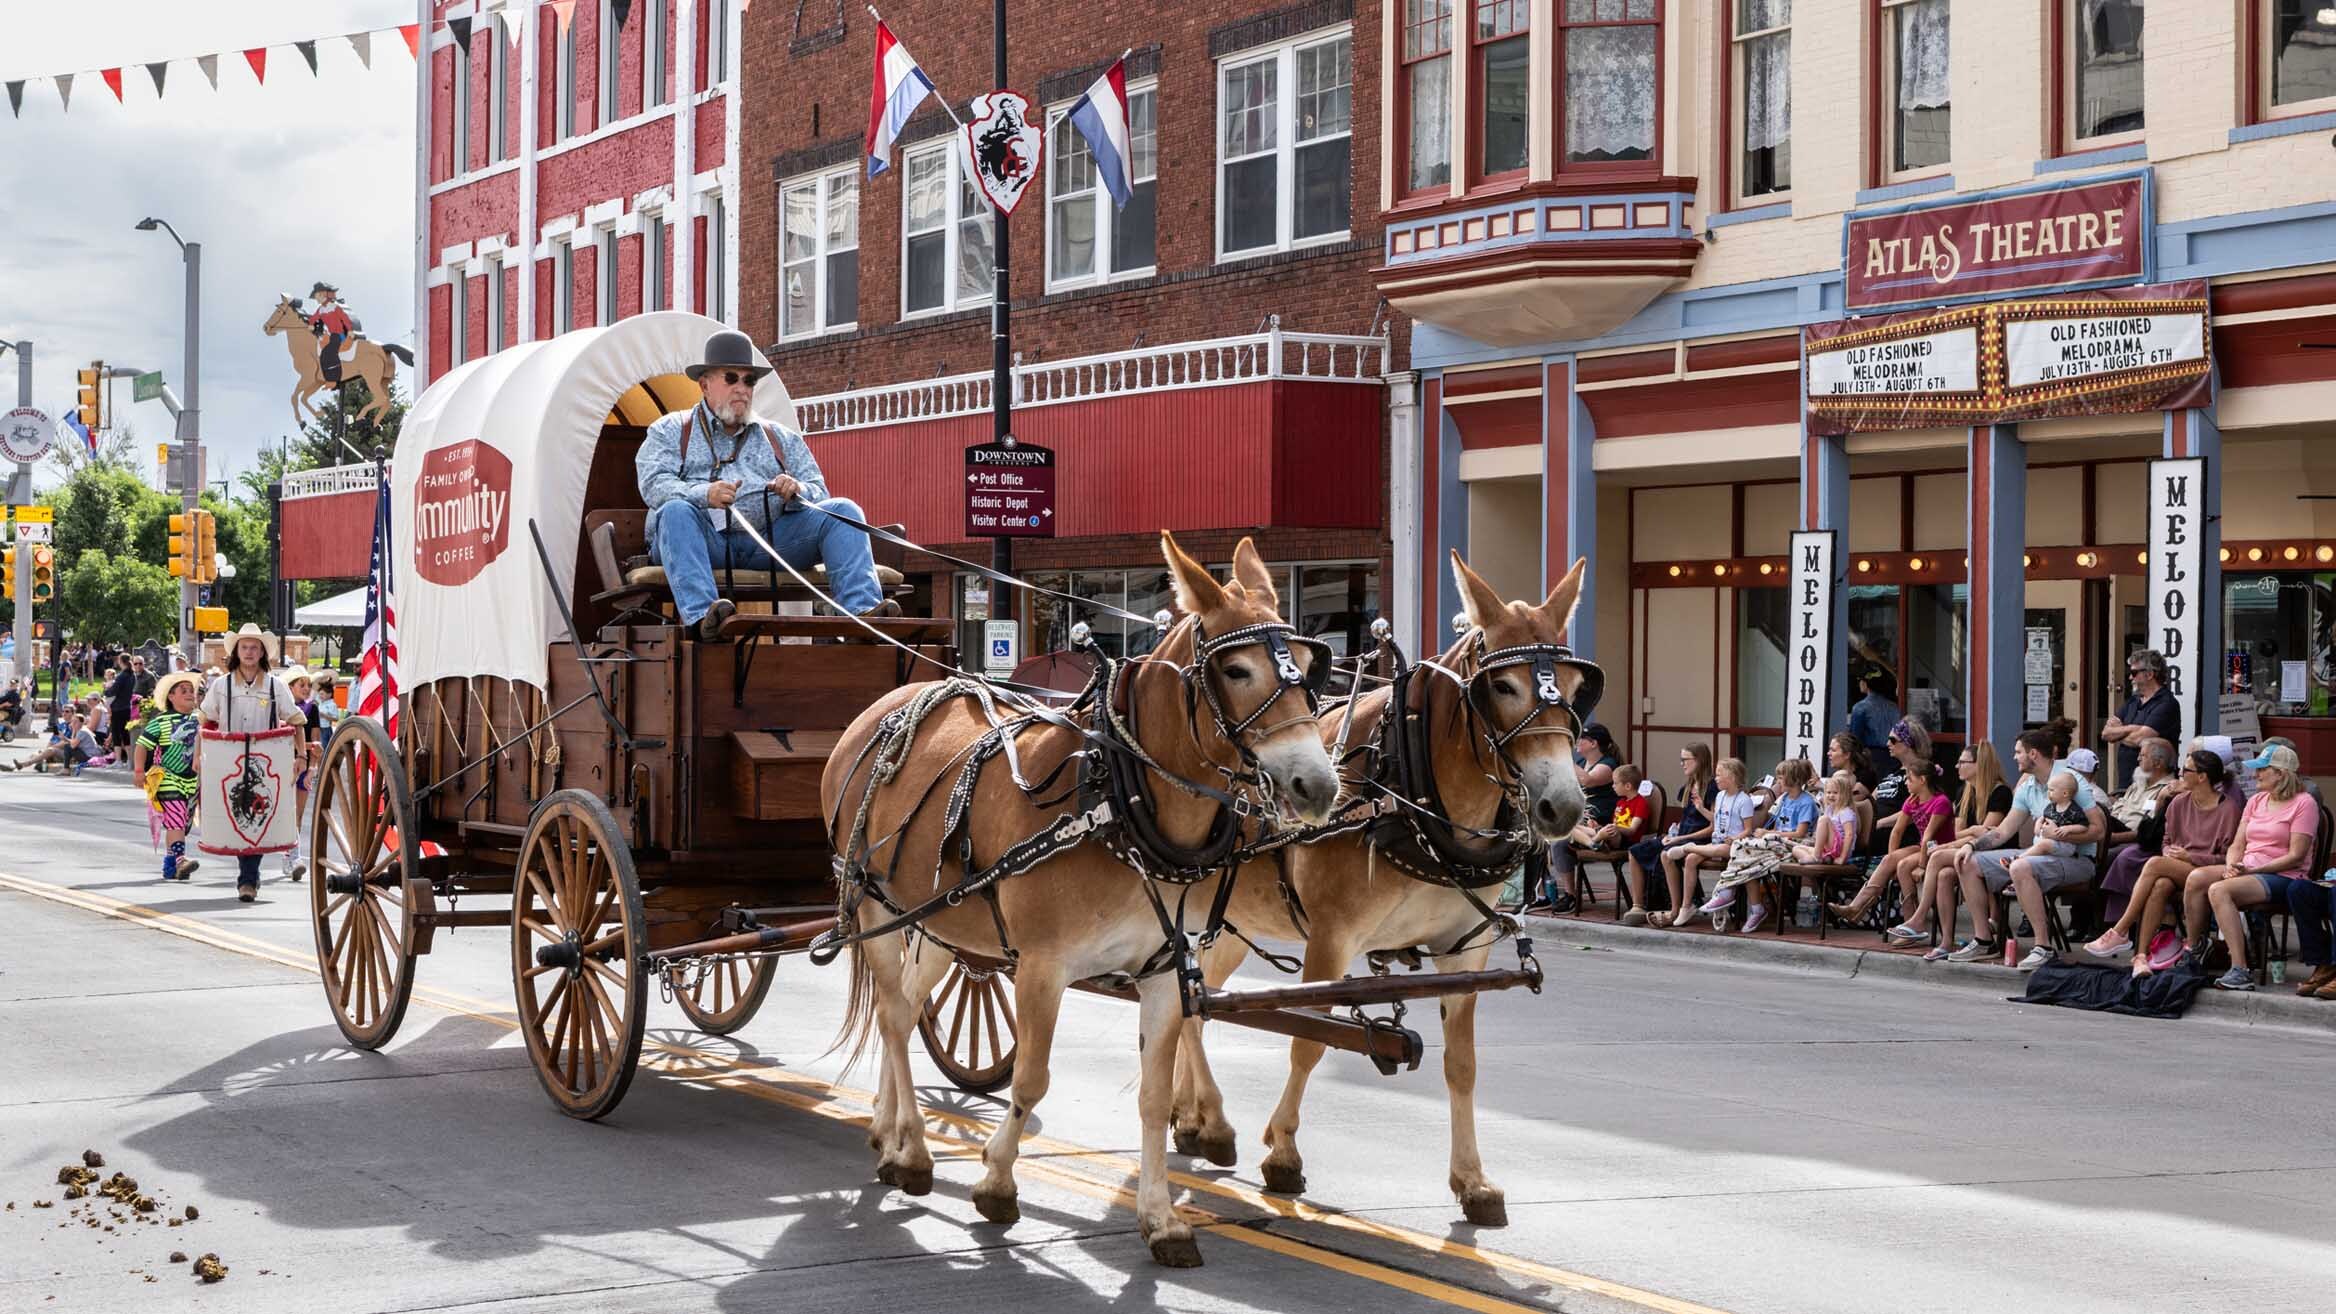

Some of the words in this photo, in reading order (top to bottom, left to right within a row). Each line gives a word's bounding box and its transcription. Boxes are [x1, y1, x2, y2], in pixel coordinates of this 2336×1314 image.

[1863, 224, 1961, 284] ATLAS
[1969, 208, 2124, 265] THEATRE
[2050, 324, 2076, 342] OLD
[2080, 317, 2151, 339] FASHIONED
[1847, 348, 1866, 365] OLD
[1869, 340, 1932, 362] FASHIONED
[2061, 337, 2143, 362] MELODRAMA
[1853, 361, 1923, 380] MELODRAMA
[2039, 366, 2064, 381] JULY
[2066, 361, 2091, 376] 13TH
[2103, 352, 2145, 371] AUGUST
[2150, 348, 2173, 364] 6TH
[1831, 381, 1854, 394] JULY
[1855, 380, 1876, 393] 13TH
[1885, 377, 1923, 391] AUGUST
[1927, 376, 1946, 390] 6TH
[974, 450, 1046, 464] DOWNTOWN
[424, 472, 458, 489] FAMILY
[980, 472, 997, 485] Post
[1001, 473, 1024, 485] Office
[417, 478, 506, 541] ommunity
[971, 496, 1002, 508] Historic
[1006, 496, 1028, 511] Depot
[972, 514, 997, 526] Visitor
[1001, 514, 1027, 527] Center
[435, 546, 474, 566] COFFEE
[2163, 476, 2188, 696] MELODR
[1797, 545, 1822, 760] MELODRA
